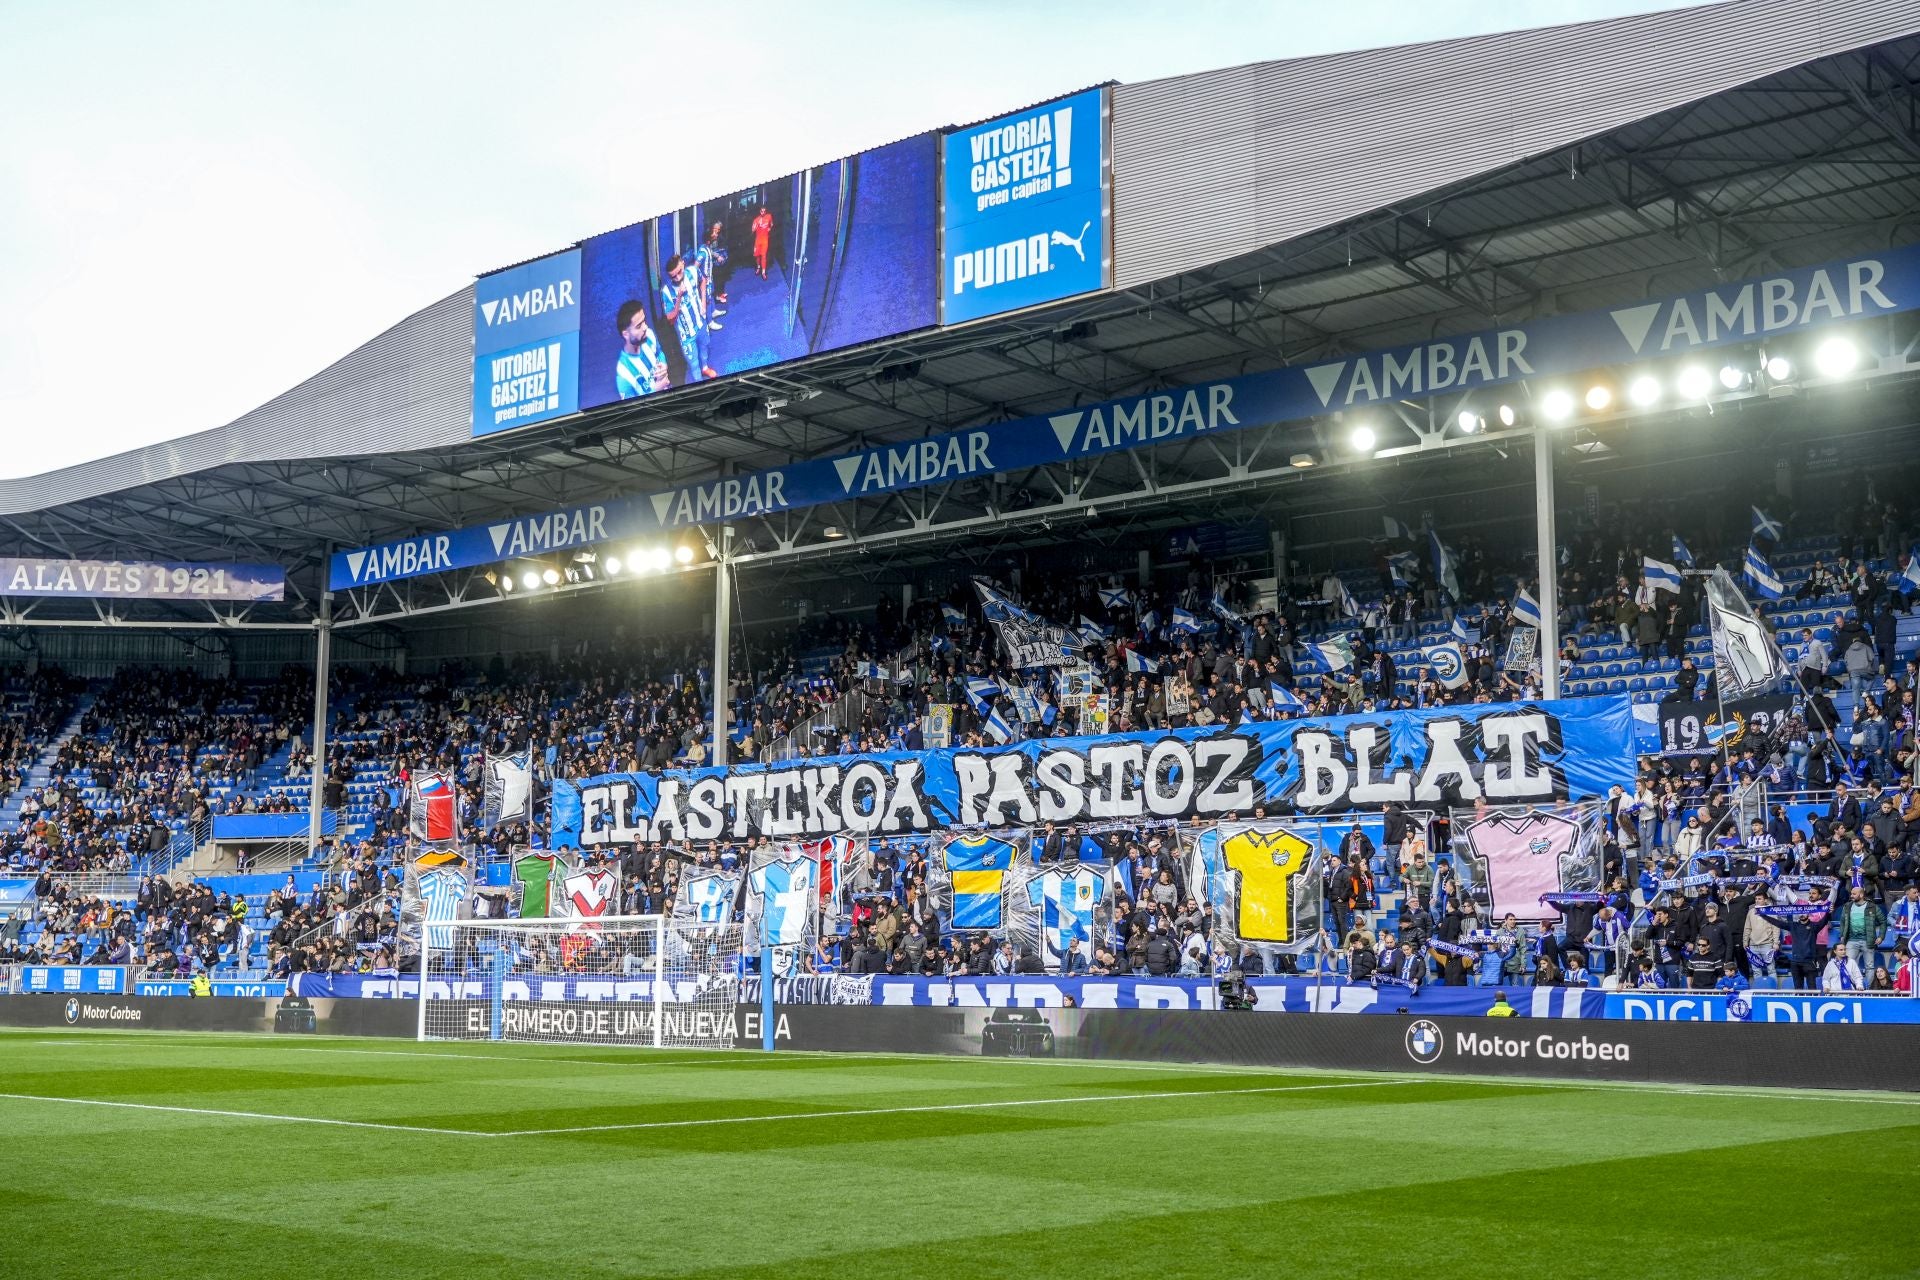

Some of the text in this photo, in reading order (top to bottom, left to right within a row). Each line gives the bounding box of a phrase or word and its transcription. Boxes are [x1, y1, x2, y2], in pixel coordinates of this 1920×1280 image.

[971, 113, 1051, 163] VITORIA
[971, 143, 1051, 194] GASTEIZ
[977, 178, 1051, 211] green capital
[498, 280, 575, 325] AMBAR
[1660, 259, 1896, 351] AMBAR
[492, 346, 546, 378] VITORIA
[1344, 330, 1534, 406] AMBAR
[491, 371, 546, 408] GASTEIZ
[495, 398, 546, 425] green capital
[1081, 384, 1239, 450] AMBAR
[861, 432, 995, 492] AMBAR
[672, 471, 788, 525] AMBAR
[507, 506, 608, 555] AMBAR
[364, 536, 452, 582] AMBAR
[153, 567, 229, 594] 1921
[1664, 715, 1700, 751] 19
[581, 762, 929, 844] ELASTIKOA
[953, 739, 1254, 825] PASIOZ
[83, 1005, 142, 1021] Motor Gorbea
[468, 1008, 791, 1039] EL RIMERO DE UNA NUEVA EA
[1624, 999, 1712, 1022] DIGI
[1767, 1001, 1863, 1024] DIGI
[1456, 1031, 1630, 1061] Motor Gorbea
